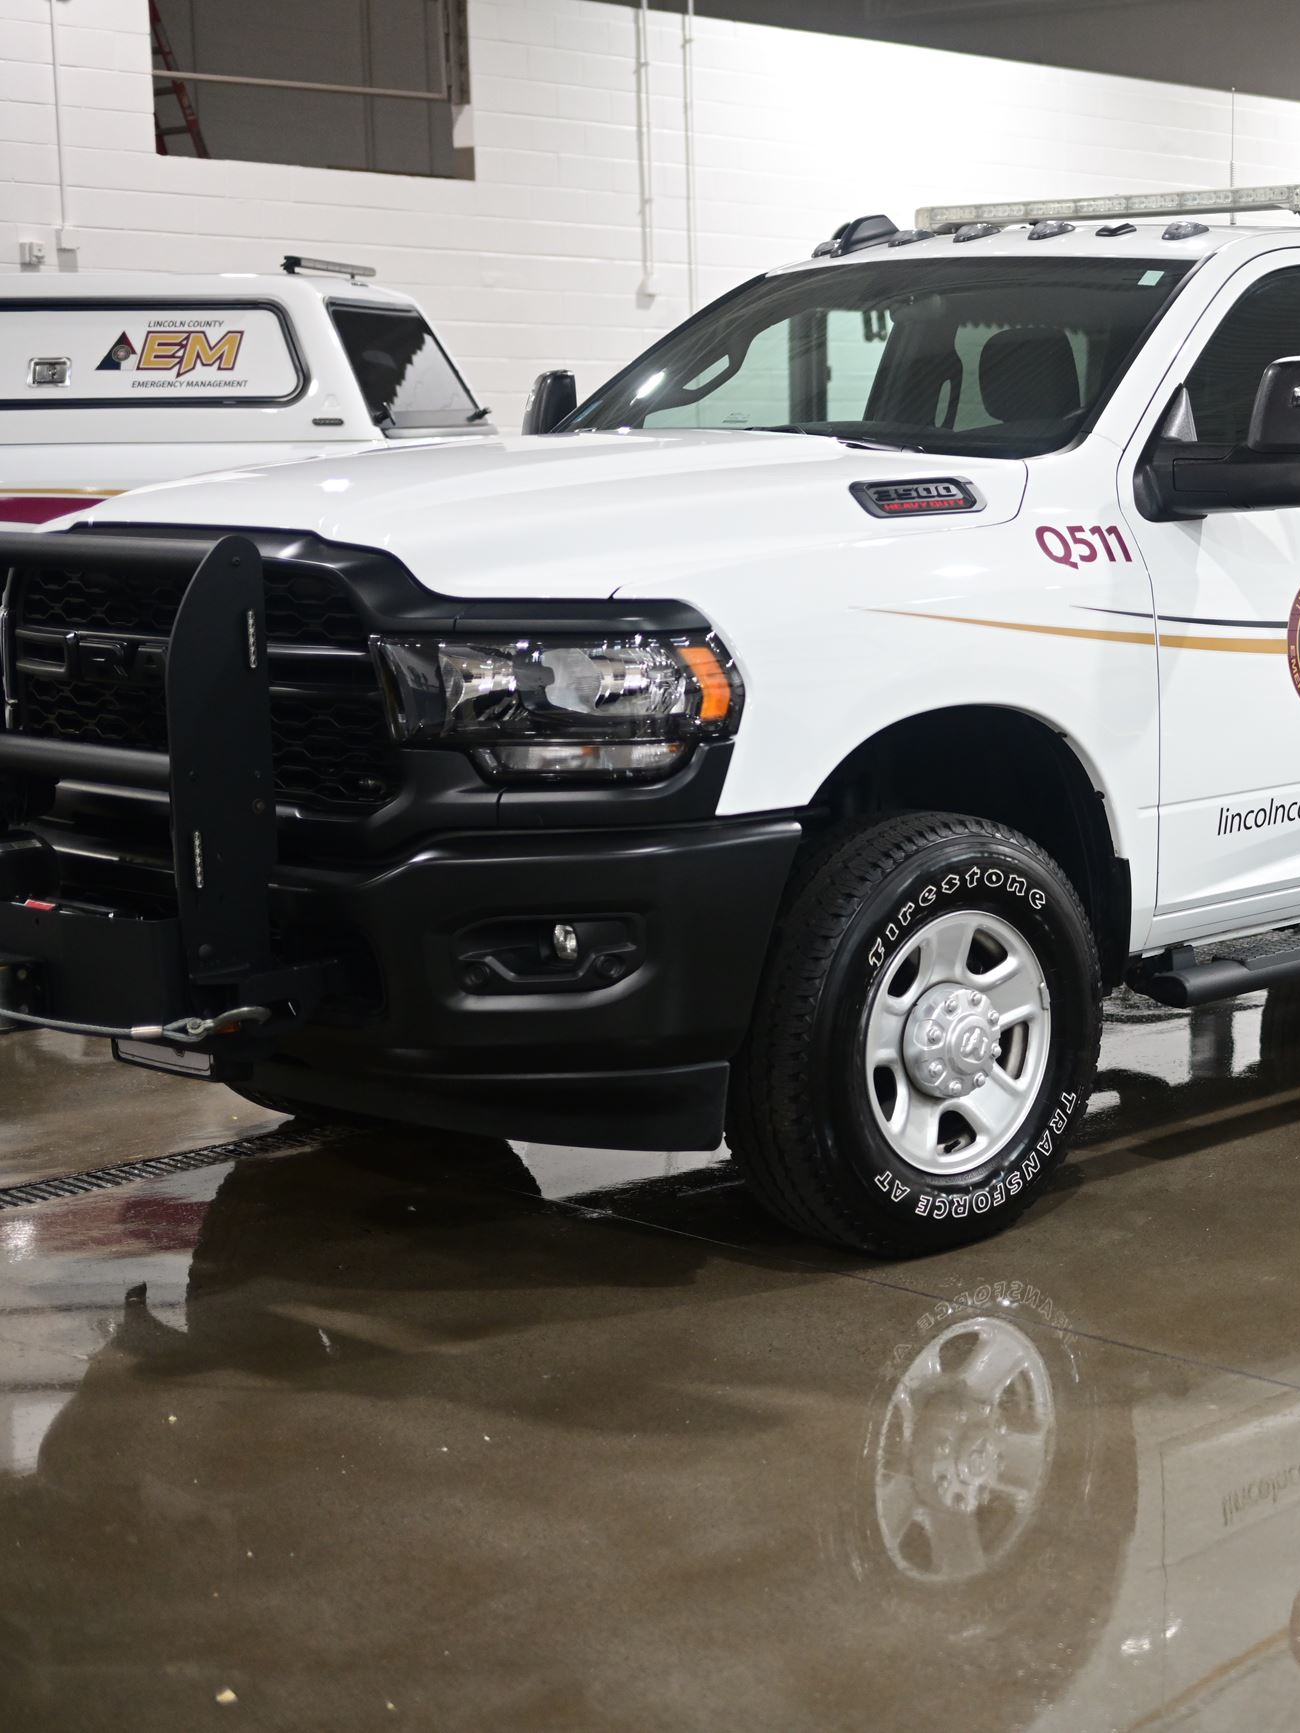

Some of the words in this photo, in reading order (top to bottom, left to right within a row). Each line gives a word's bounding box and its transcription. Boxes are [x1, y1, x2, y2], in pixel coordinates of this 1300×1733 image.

[147, 320, 187, 328] LINCOLN
[187, 320, 225, 328] COUNTY
[136, 330, 245, 379] EM
[131, 380, 185, 389] EMERGENCY
[186, 379, 249, 388] MANAGEMENT
[872, 484, 958, 502] 3500
[882, 500, 927, 512] HEAVY
[1034, 525, 1133, 570] Q511
[867, 865, 1047, 969] Firestone
[915, 1091, 1078, 1220] TRANSFORCE
[873, 1169, 911, 1203] AT
